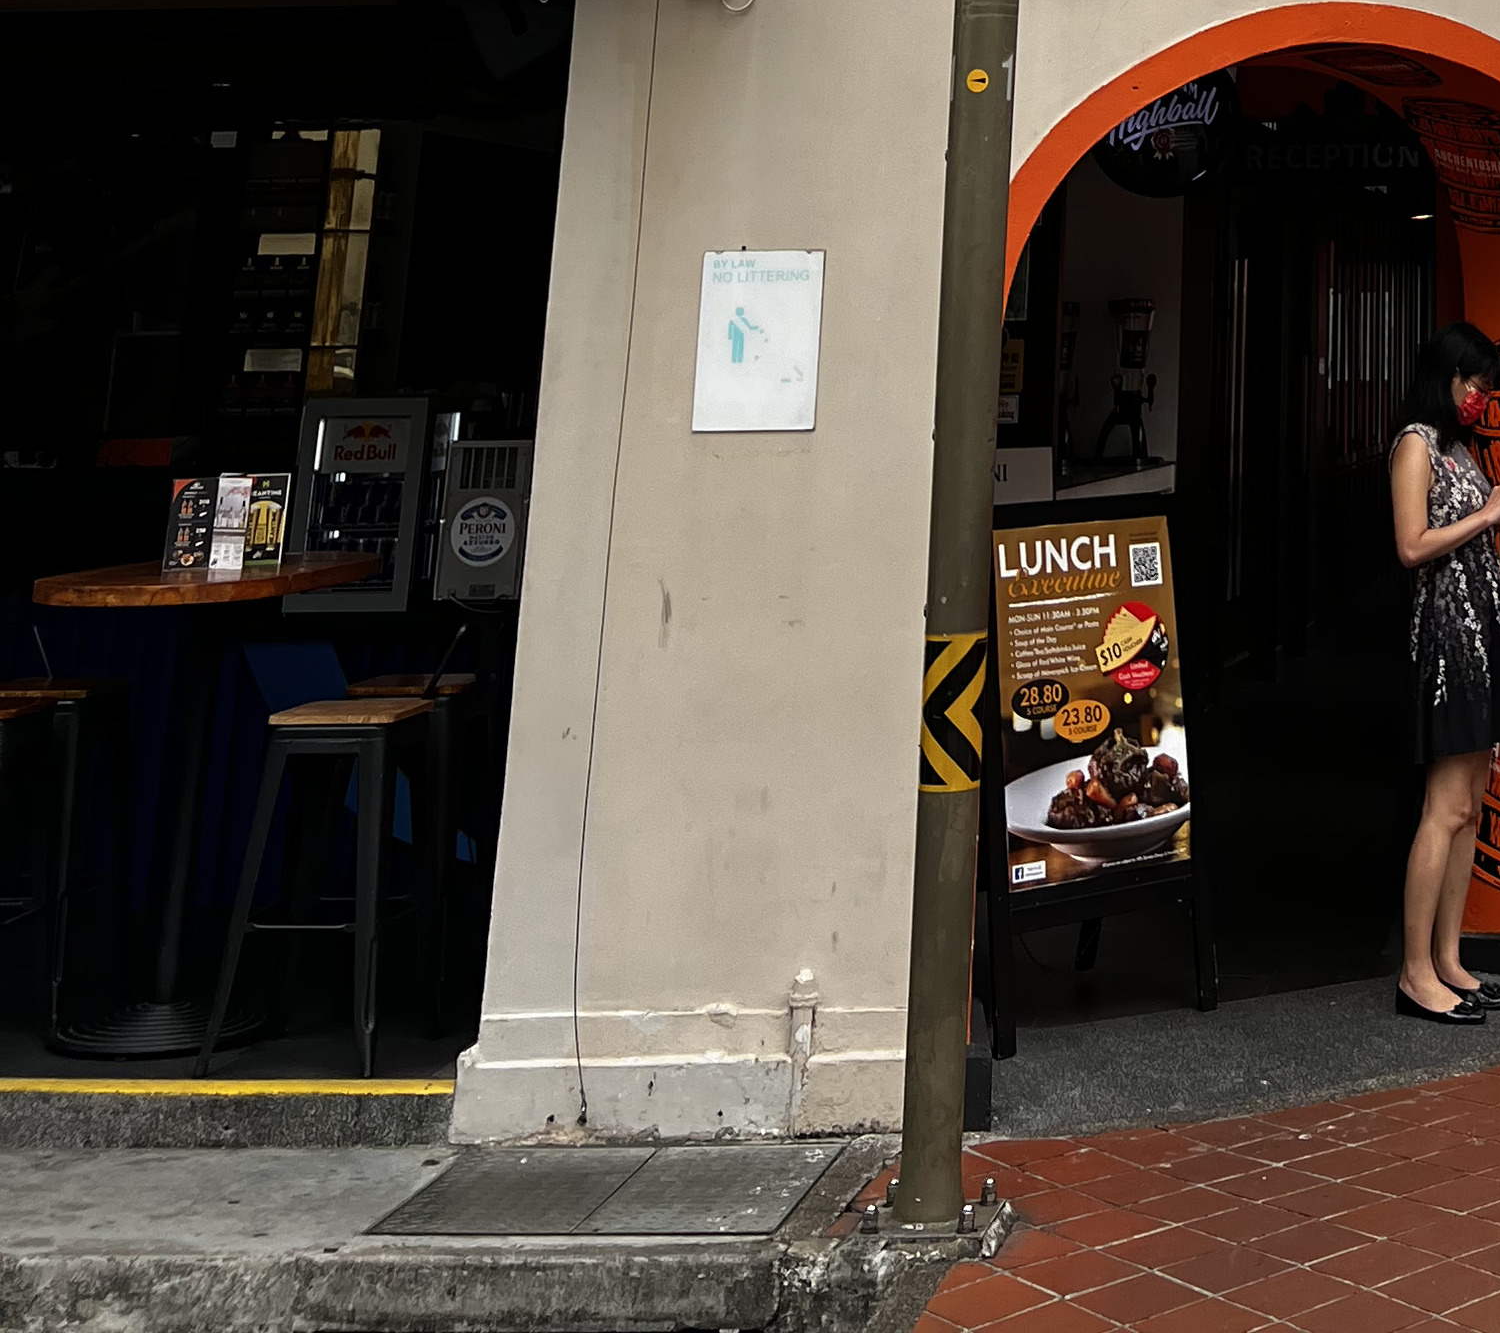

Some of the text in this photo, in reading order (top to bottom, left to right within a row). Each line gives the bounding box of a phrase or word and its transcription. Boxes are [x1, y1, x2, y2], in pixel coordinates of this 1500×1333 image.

[1244, 141, 1420, 171] RECEPTION
[713, 258, 756, 269] BY LAW
[712, 269, 810, 283] NO LITTERING
[333, 444, 397, 461] Red Bull
[459, 522, 506, 535] PERONI
[998, 533, 1117, 578] LUNCH
[1008, 567, 1122, 598] Executive
[1100, 642, 1122, 666] $10
[1019, 683, 1063, 707] 28.80
[1062, 704, 1103, 727] 23.80
[1073, 724, 1098, 735] COURSE
